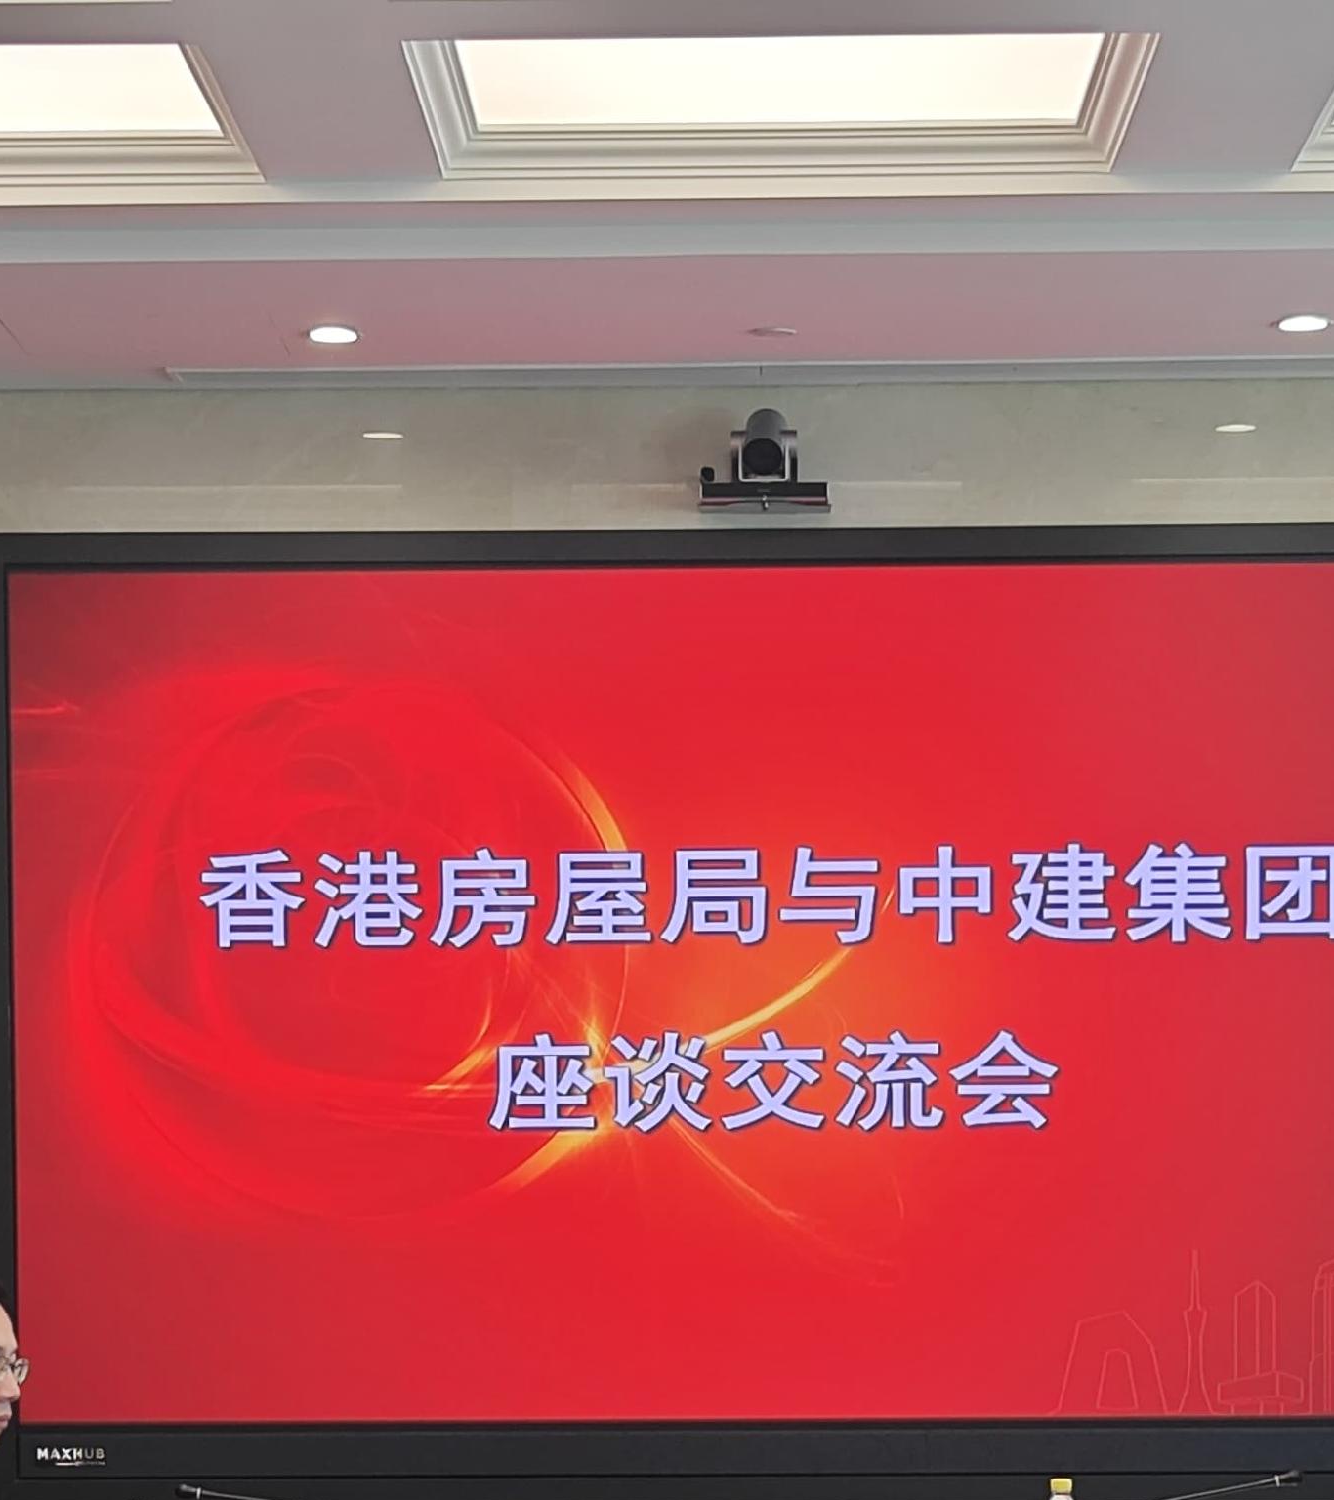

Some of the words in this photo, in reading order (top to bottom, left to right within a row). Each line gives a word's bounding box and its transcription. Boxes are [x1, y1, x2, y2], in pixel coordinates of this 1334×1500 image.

[490, 1031, 1058, 1131] 座谈交流会
[36, 1447, 105, 1461] MAXHUB
